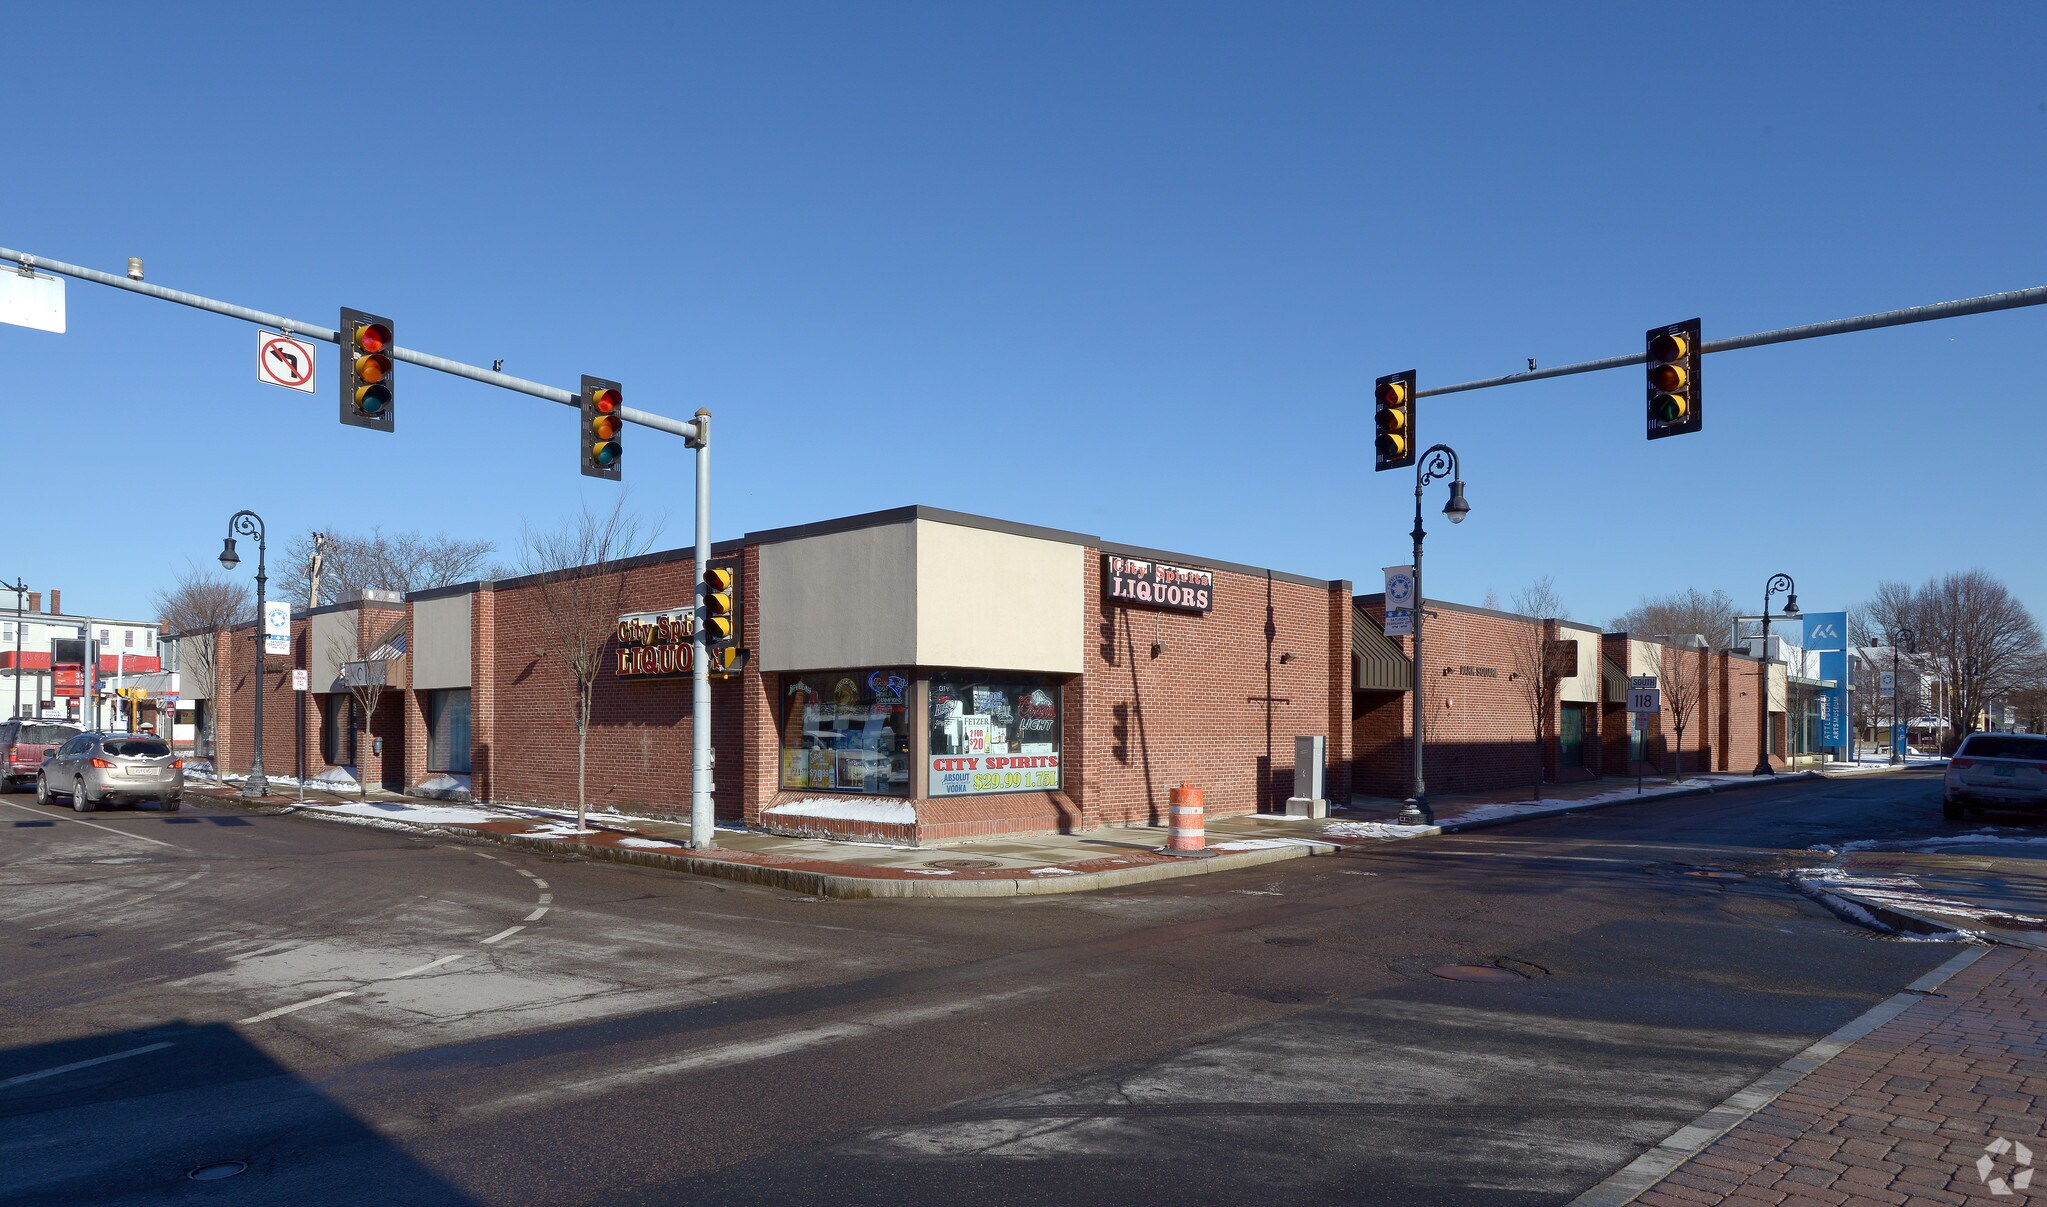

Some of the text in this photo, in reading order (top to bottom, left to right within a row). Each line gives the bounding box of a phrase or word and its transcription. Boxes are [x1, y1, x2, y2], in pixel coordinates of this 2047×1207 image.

[1113, 559, 1209, 586] City Spirits
[1112, 577, 1208, 609] LIQUORS
[617, 619, 653, 645] City
[938, 685, 950, 693] CITY
[1635, 694, 1651, 707] 118
[1019, 718, 1054, 731] LIGHT
[969, 738, 984, 750] $20
[933, 756, 1059, 771] CITY SPIRITS
[943, 773, 970, 782] ABSOLUT
[973, 770, 1058, 791] $29.99 1.75L
[946, 784, 967, 793] VODKA
